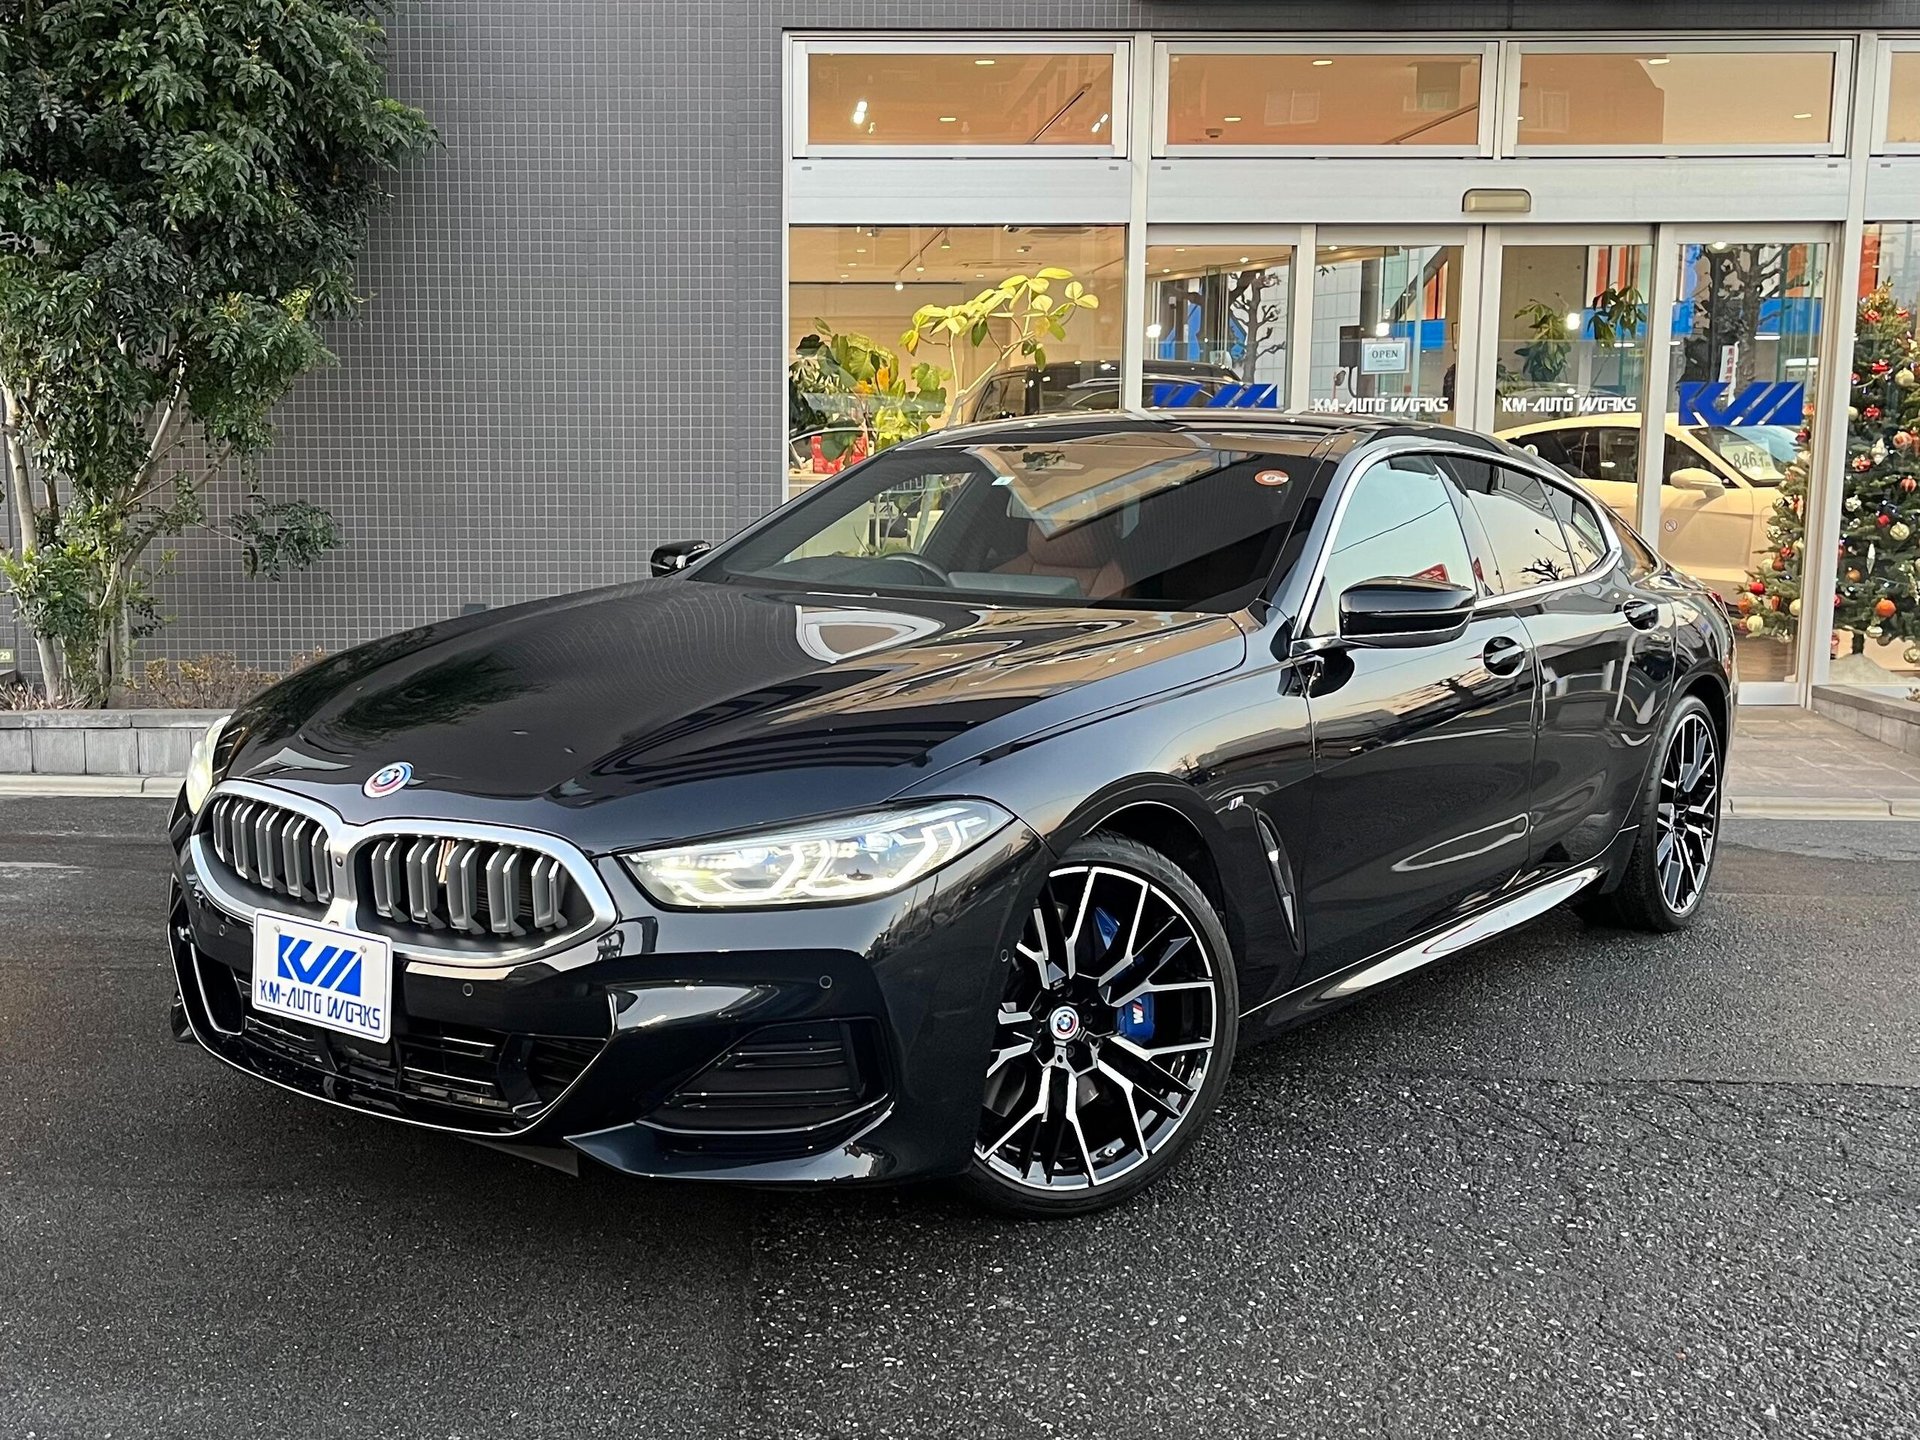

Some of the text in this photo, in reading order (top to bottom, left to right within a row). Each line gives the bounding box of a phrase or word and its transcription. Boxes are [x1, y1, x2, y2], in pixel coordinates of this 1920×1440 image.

[1371, 349, 1398, 359] OPEN
[1313, 396, 1449, 413] KM-AUTO WORKS
[1501, 396, 1637, 412] KM-AUTO WORKS
[259, 978, 381, 1031] KM-AUTO WORKS
